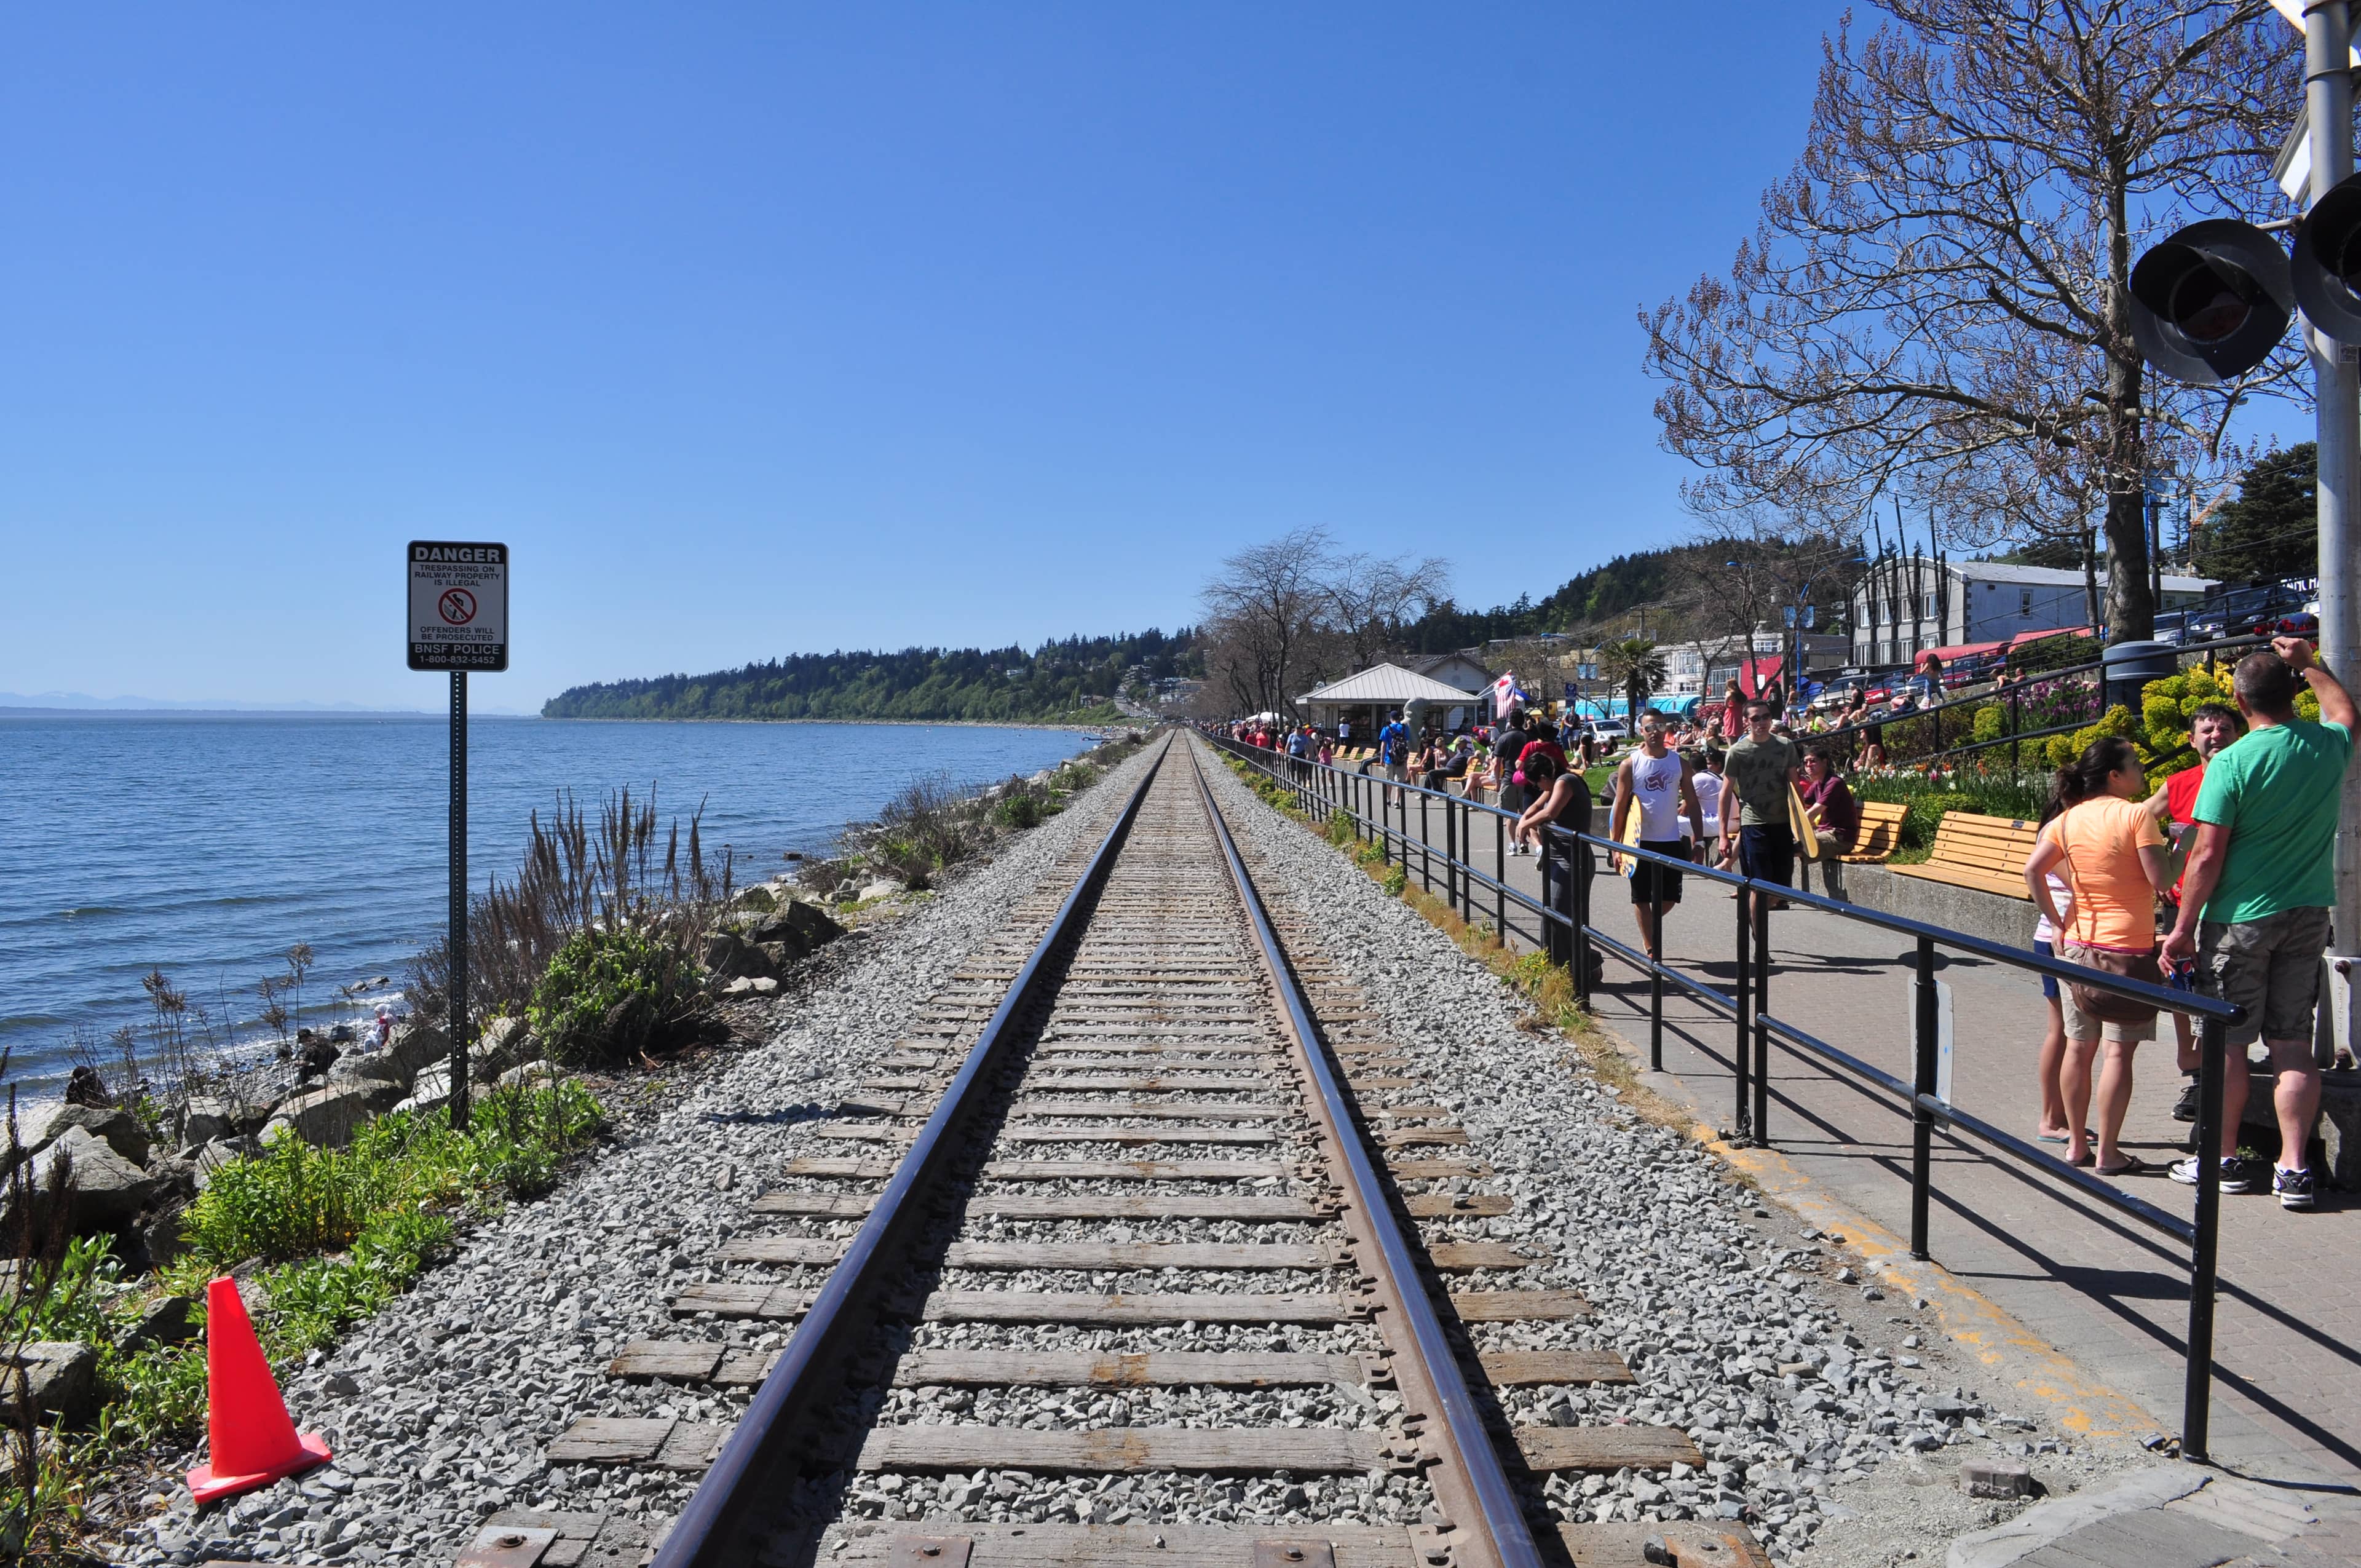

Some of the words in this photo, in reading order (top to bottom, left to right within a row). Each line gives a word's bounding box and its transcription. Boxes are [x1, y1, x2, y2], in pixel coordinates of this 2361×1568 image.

[415, 547, 500, 562] DANGER
[414, 644, 448, 653] BNSF
[454, 645, 500, 654] POLICE
